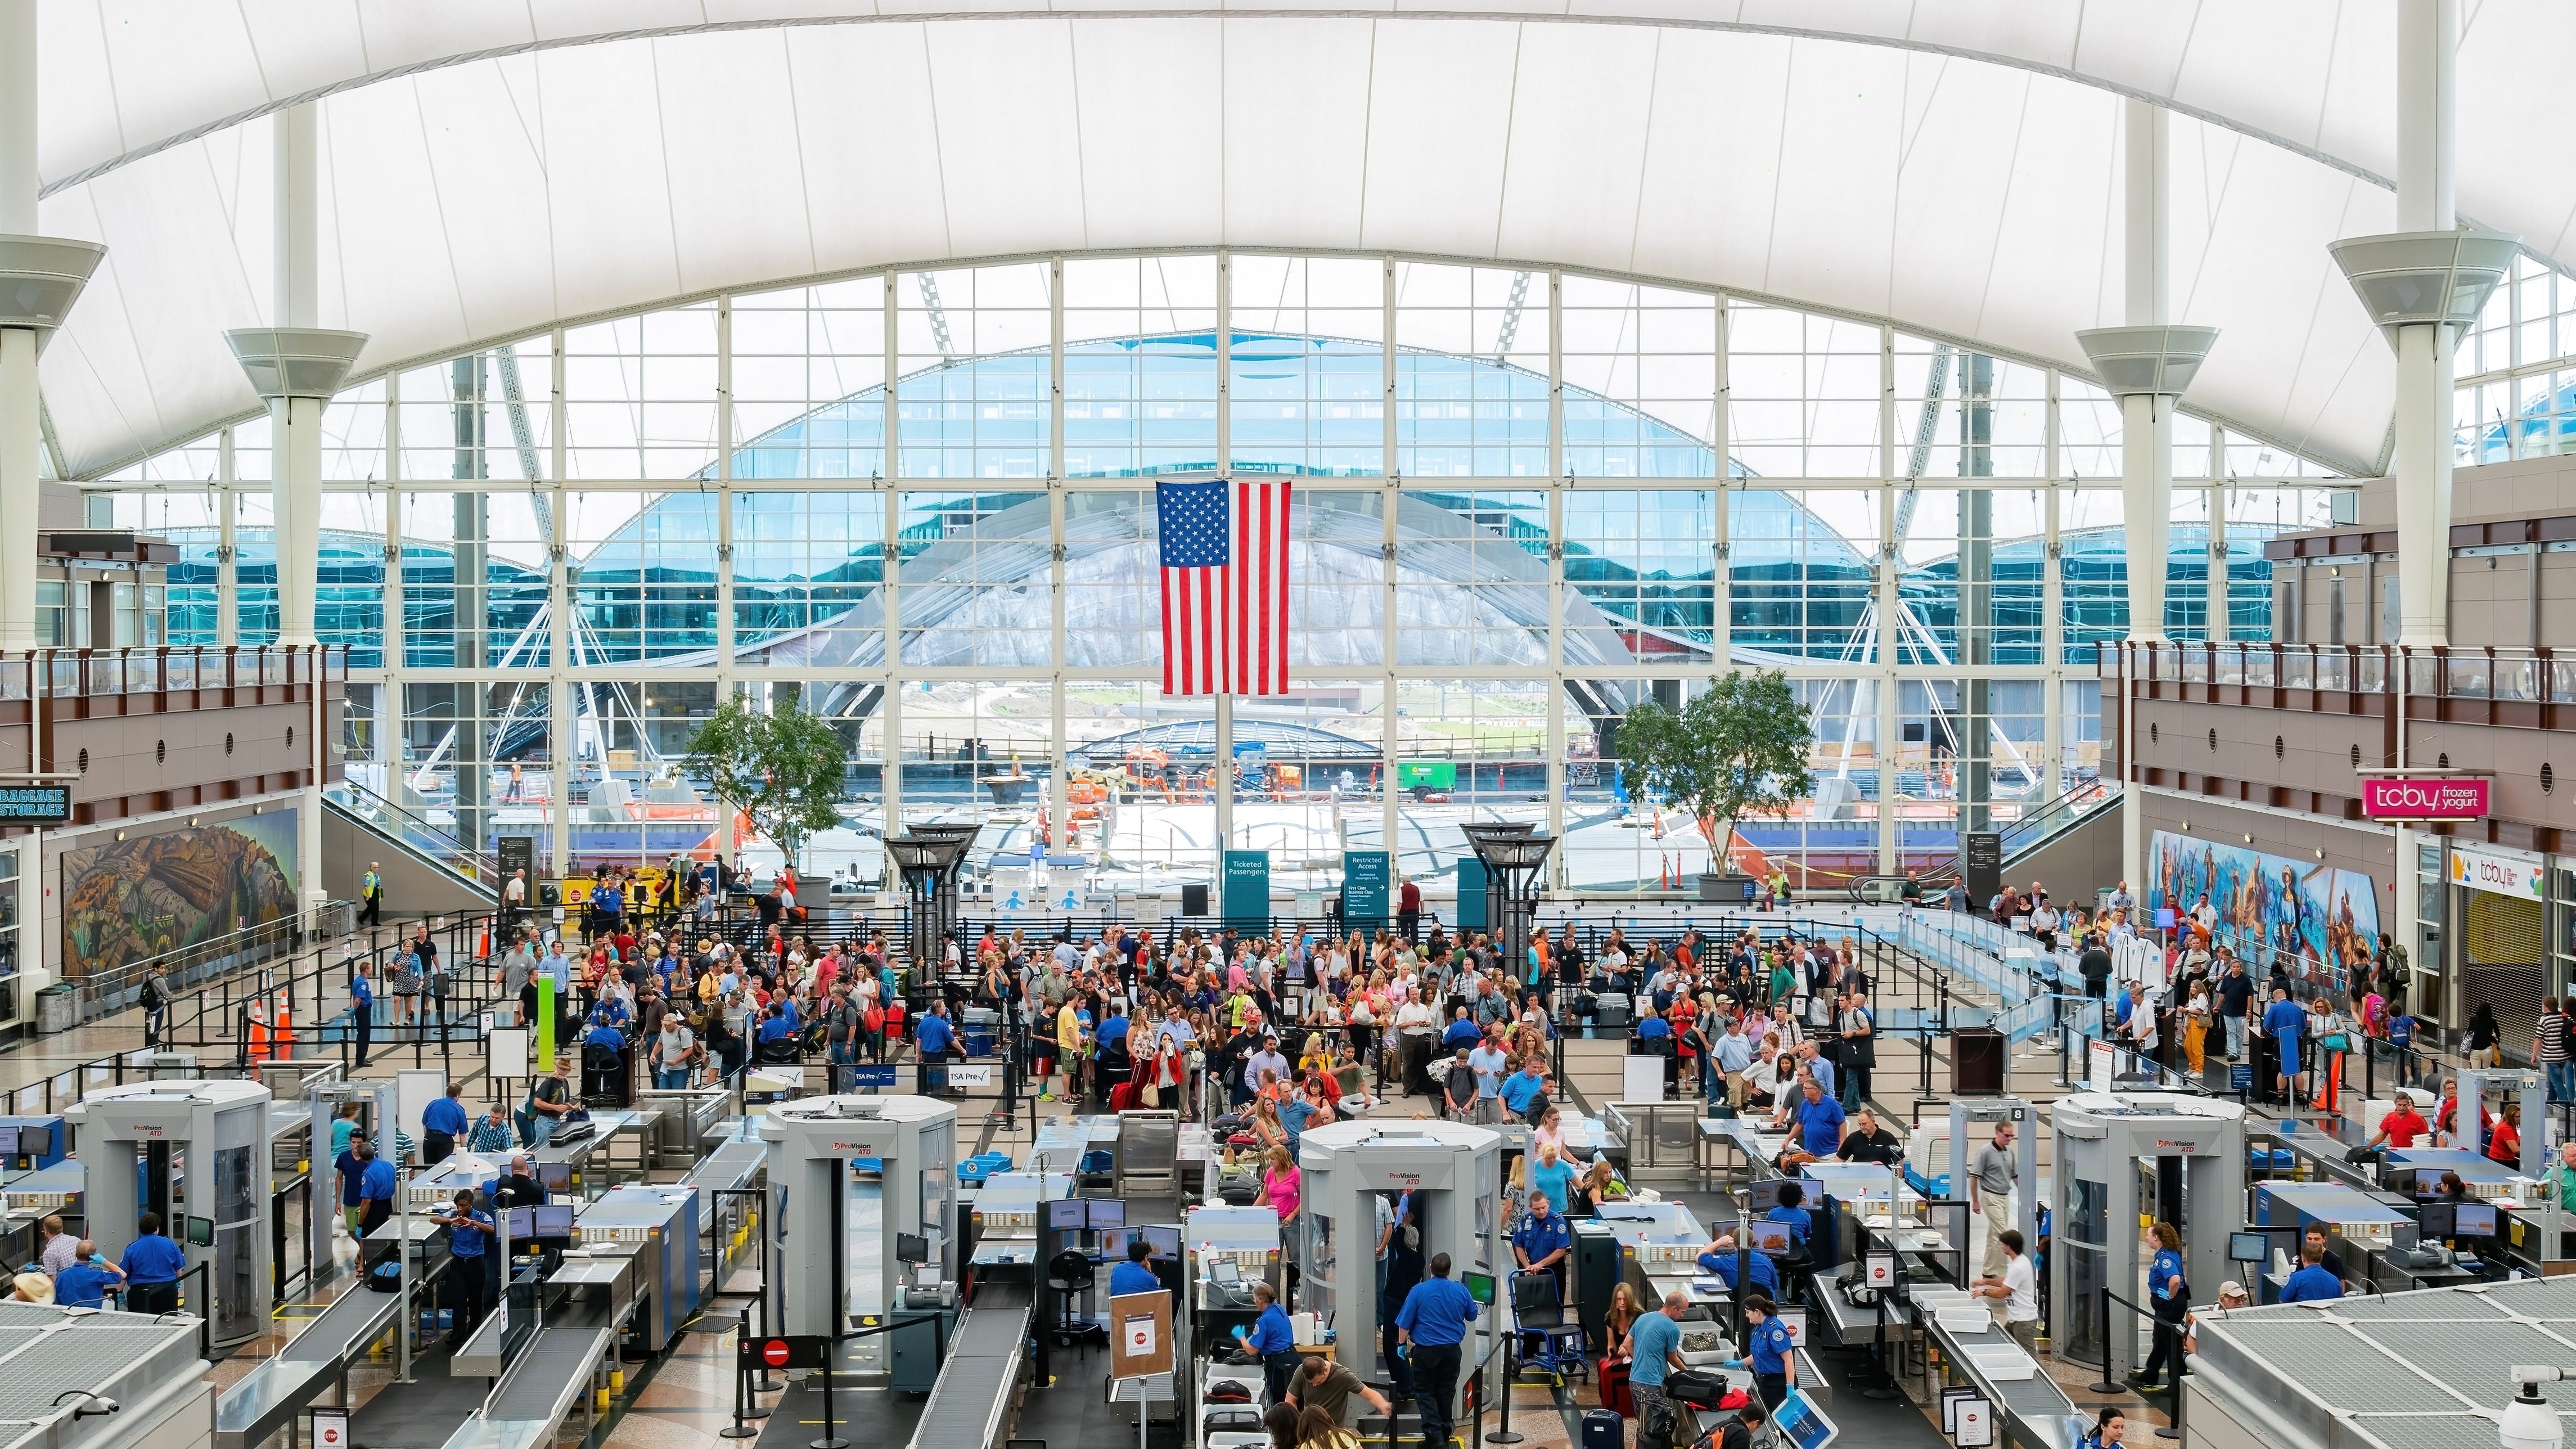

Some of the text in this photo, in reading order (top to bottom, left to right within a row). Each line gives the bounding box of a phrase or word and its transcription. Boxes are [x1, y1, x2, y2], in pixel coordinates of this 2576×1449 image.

[0, 790, 64, 802] BAGGAGE
[2442, 785, 2477, 798] frozen
[2377, 784, 2439, 811] tcby
[2442, 797, 2478, 810] yogurt
[0, 803, 64, 816] STORAGE
[2481, 860, 2506, 889] tcby
[2014, 1110, 2021, 1119] 8
[402, 1172, 406, 1181] 3
[2546, 1205, 2550, 1213] 9
[502, 1213, 505, 1222] 4
[1184, 1217, 1188, 1226] 6
[1742, 1215, 1746, 1223] 7
